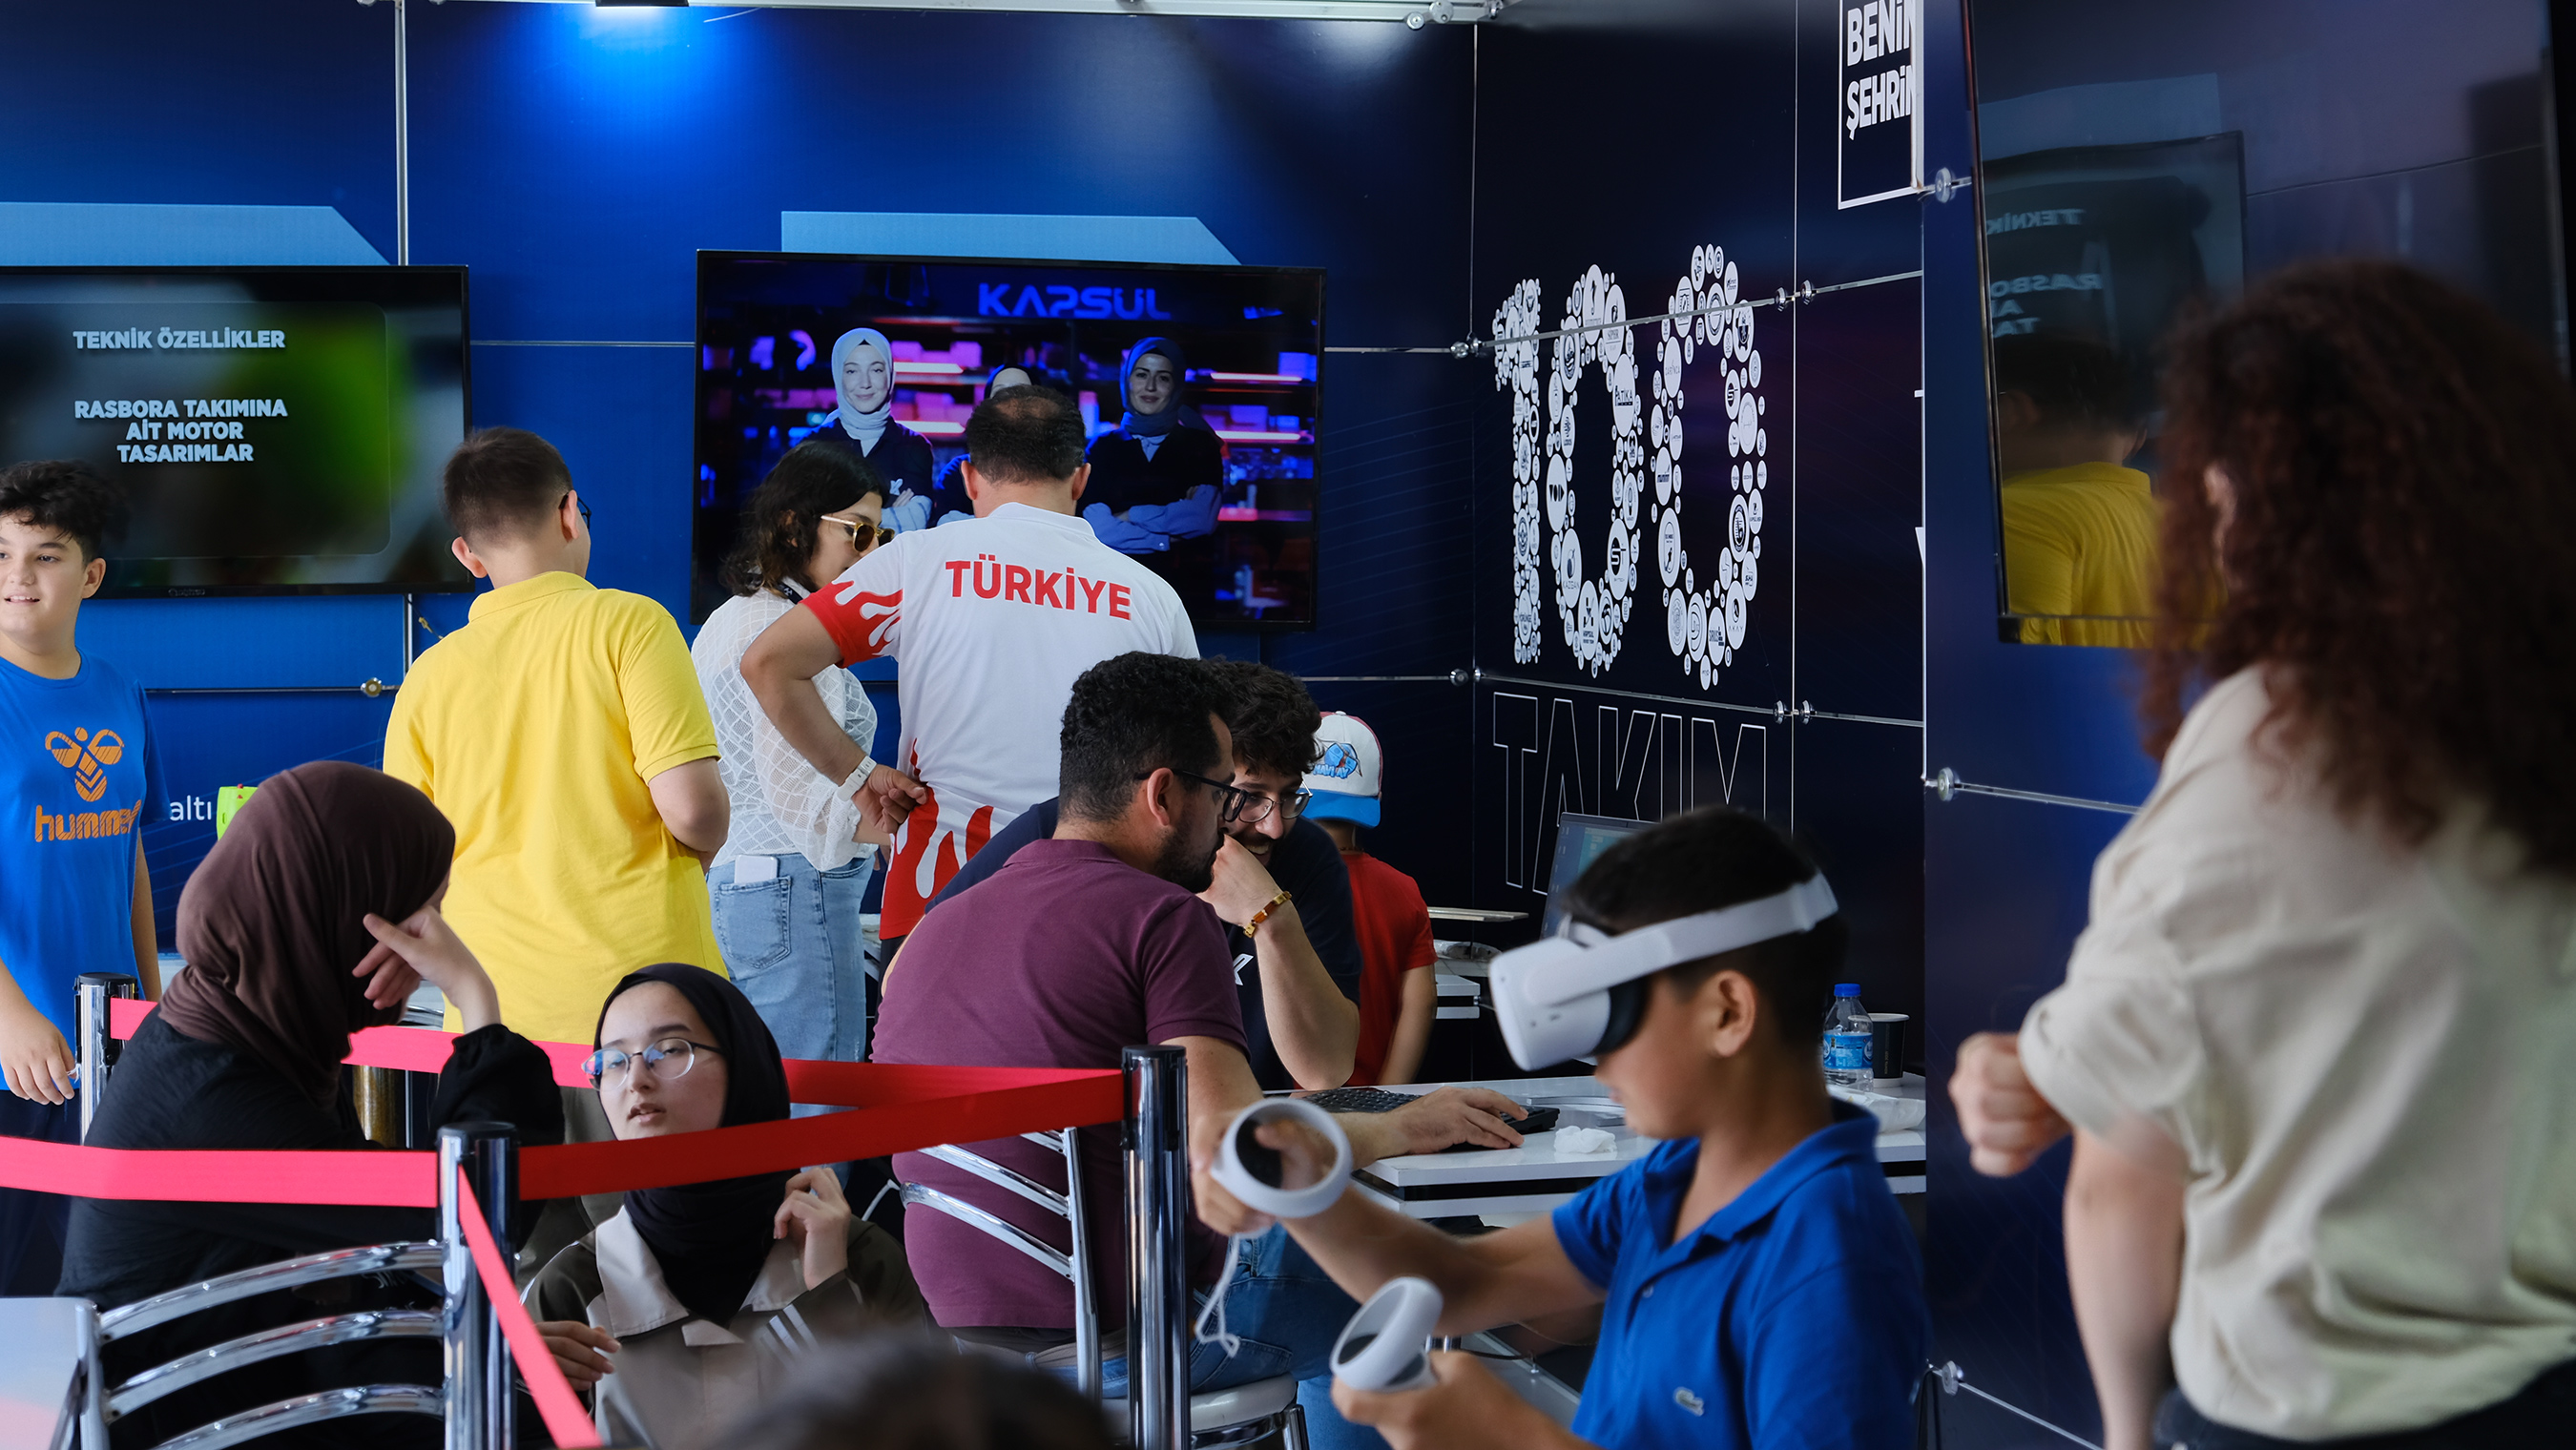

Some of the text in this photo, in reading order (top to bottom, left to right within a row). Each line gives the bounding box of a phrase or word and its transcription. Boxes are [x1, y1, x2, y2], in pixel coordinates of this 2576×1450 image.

[73, 326, 285, 349] TEKNİK ÖZELLİKLER
[74, 399, 287, 419] RASBORA TAKIMINA
[126, 418, 244, 440] AİT MOTOR
[117, 443, 253, 463] TASARIMLAR
[945, 553, 1132, 620] TÜRKİYE
